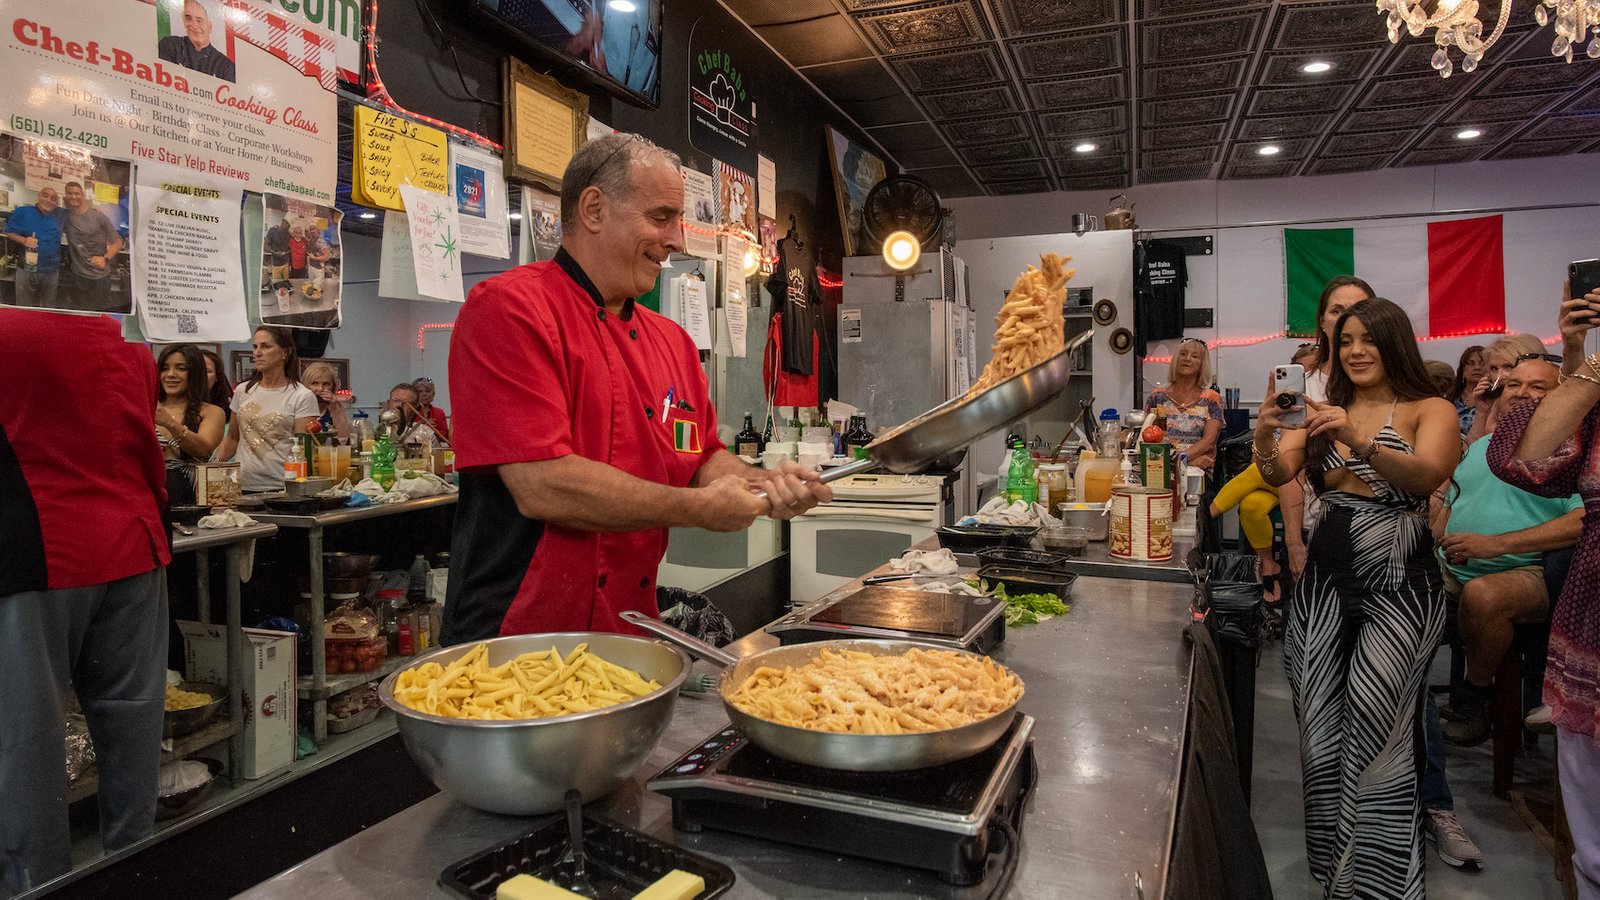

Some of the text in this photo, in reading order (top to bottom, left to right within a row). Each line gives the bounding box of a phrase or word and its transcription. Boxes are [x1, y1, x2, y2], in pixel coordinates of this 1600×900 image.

[698, 49, 747, 103] Chef Baba
[10, 113, 108, 149] (561) 542-4230
[56, 83, 80, 98] Fun
[83, 90, 110, 107] Date
[112, 98, 142, 117] Night
[152, 110, 192, 133] Birthday
[196, 123, 220, 138] Class
[228, 131, 271, 152] Corporate
[272, 144, 313, 164] Workshops
[130, 89, 266, 137] Email us to reserve your class.
[215, 84, 278, 125] Cooking
[282, 106, 319, 134] Class
[72, 104, 96, 119] Join
[100, 113, 112, 123] us
[114, 115, 126, 128] @
[129, 118, 150, 133] Our
[152, 124, 189, 144] Kitchen
[191, 136, 202, 146] or
[203, 140, 213, 150] at
[214, 143, 235, 156] Your
[237, 149, 263, 164] Home
[271, 156, 305, 174] Business.
[131, 140, 251, 181] Five Star Yelp Reviews
[194, 187, 220, 199] EVENTS
[463, 184, 478, 196] 2021
[156, 206, 219, 224] SPECIAL EVENTS
